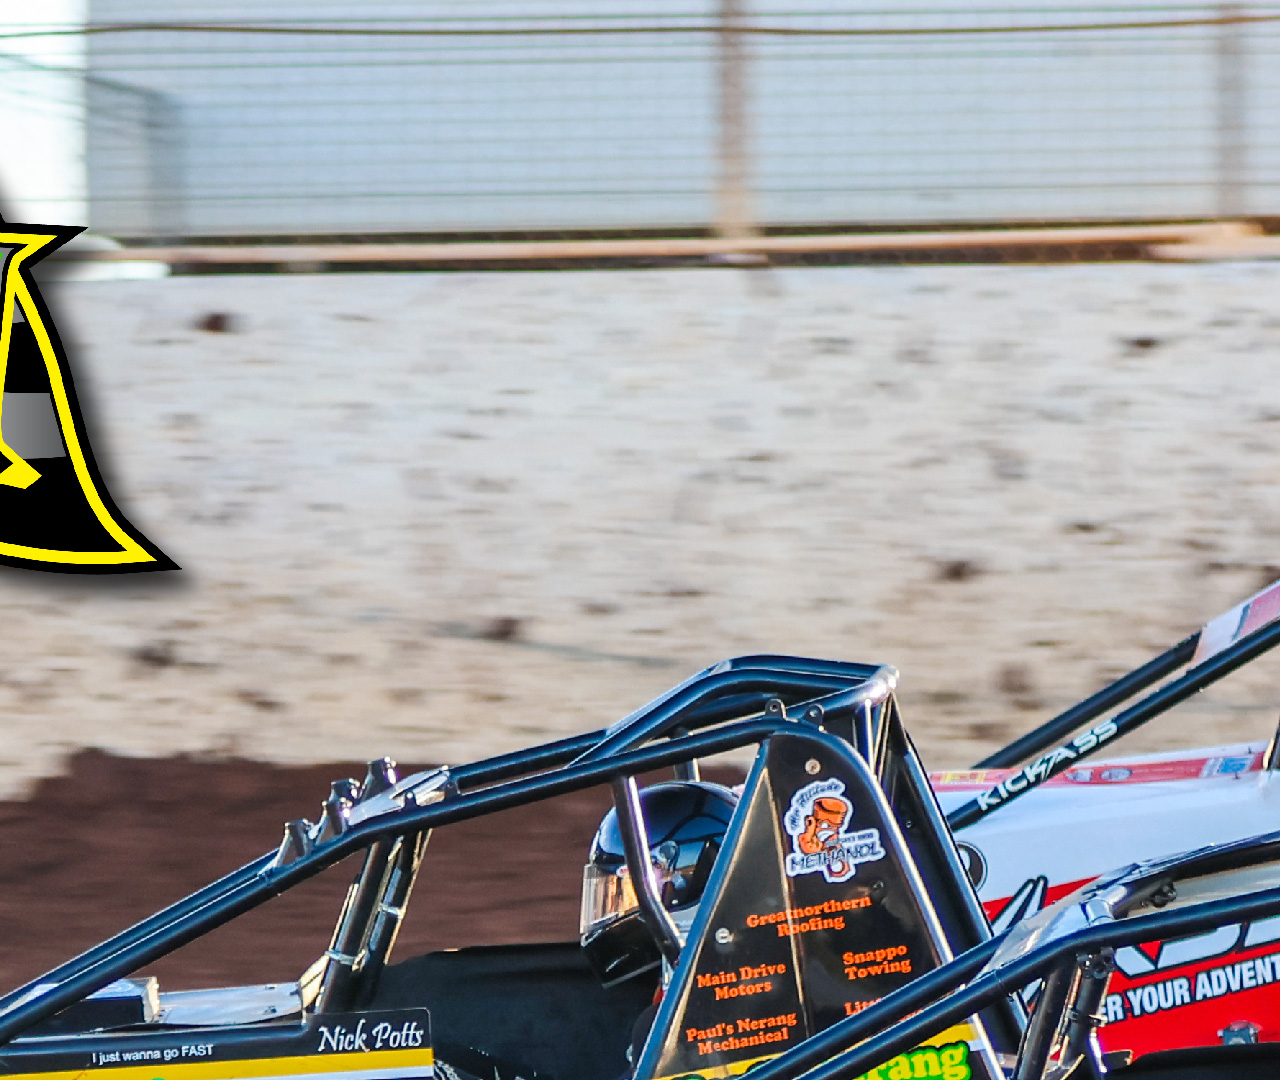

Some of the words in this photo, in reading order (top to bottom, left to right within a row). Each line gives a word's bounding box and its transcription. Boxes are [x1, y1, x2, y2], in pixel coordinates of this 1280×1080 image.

[976, 718, 1118, 811] KICKASS
[791, 841, 882, 871] METHANOL
[747, 897, 872, 928] Greatnorthern
[777, 916, 845, 937] Roofing
[842, 945, 907, 965] Snappo
[696, 971, 737, 988] Main
[739, 963, 786, 980] Drive
[845, 959, 912, 980] Towing
[714, 981, 773, 1001] Motors
[1126, 976, 1191, 1016] YOUR
[318, 1019, 370, 1052] Nick
[372, 1021, 424, 1050] Potts
[686, 1021, 735, 1042] Paul's
[736, 1013, 798, 1034] Nerang
[698, 1027, 790, 1055] Mechanical
[91, 1052, 97, 1064] I
[99, 1051, 121, 1065] just
[122, 1049, 162, 1061] wanna
[163, 1049, 179, 1061] go
[181, 1044, 214, 1057] FAST
